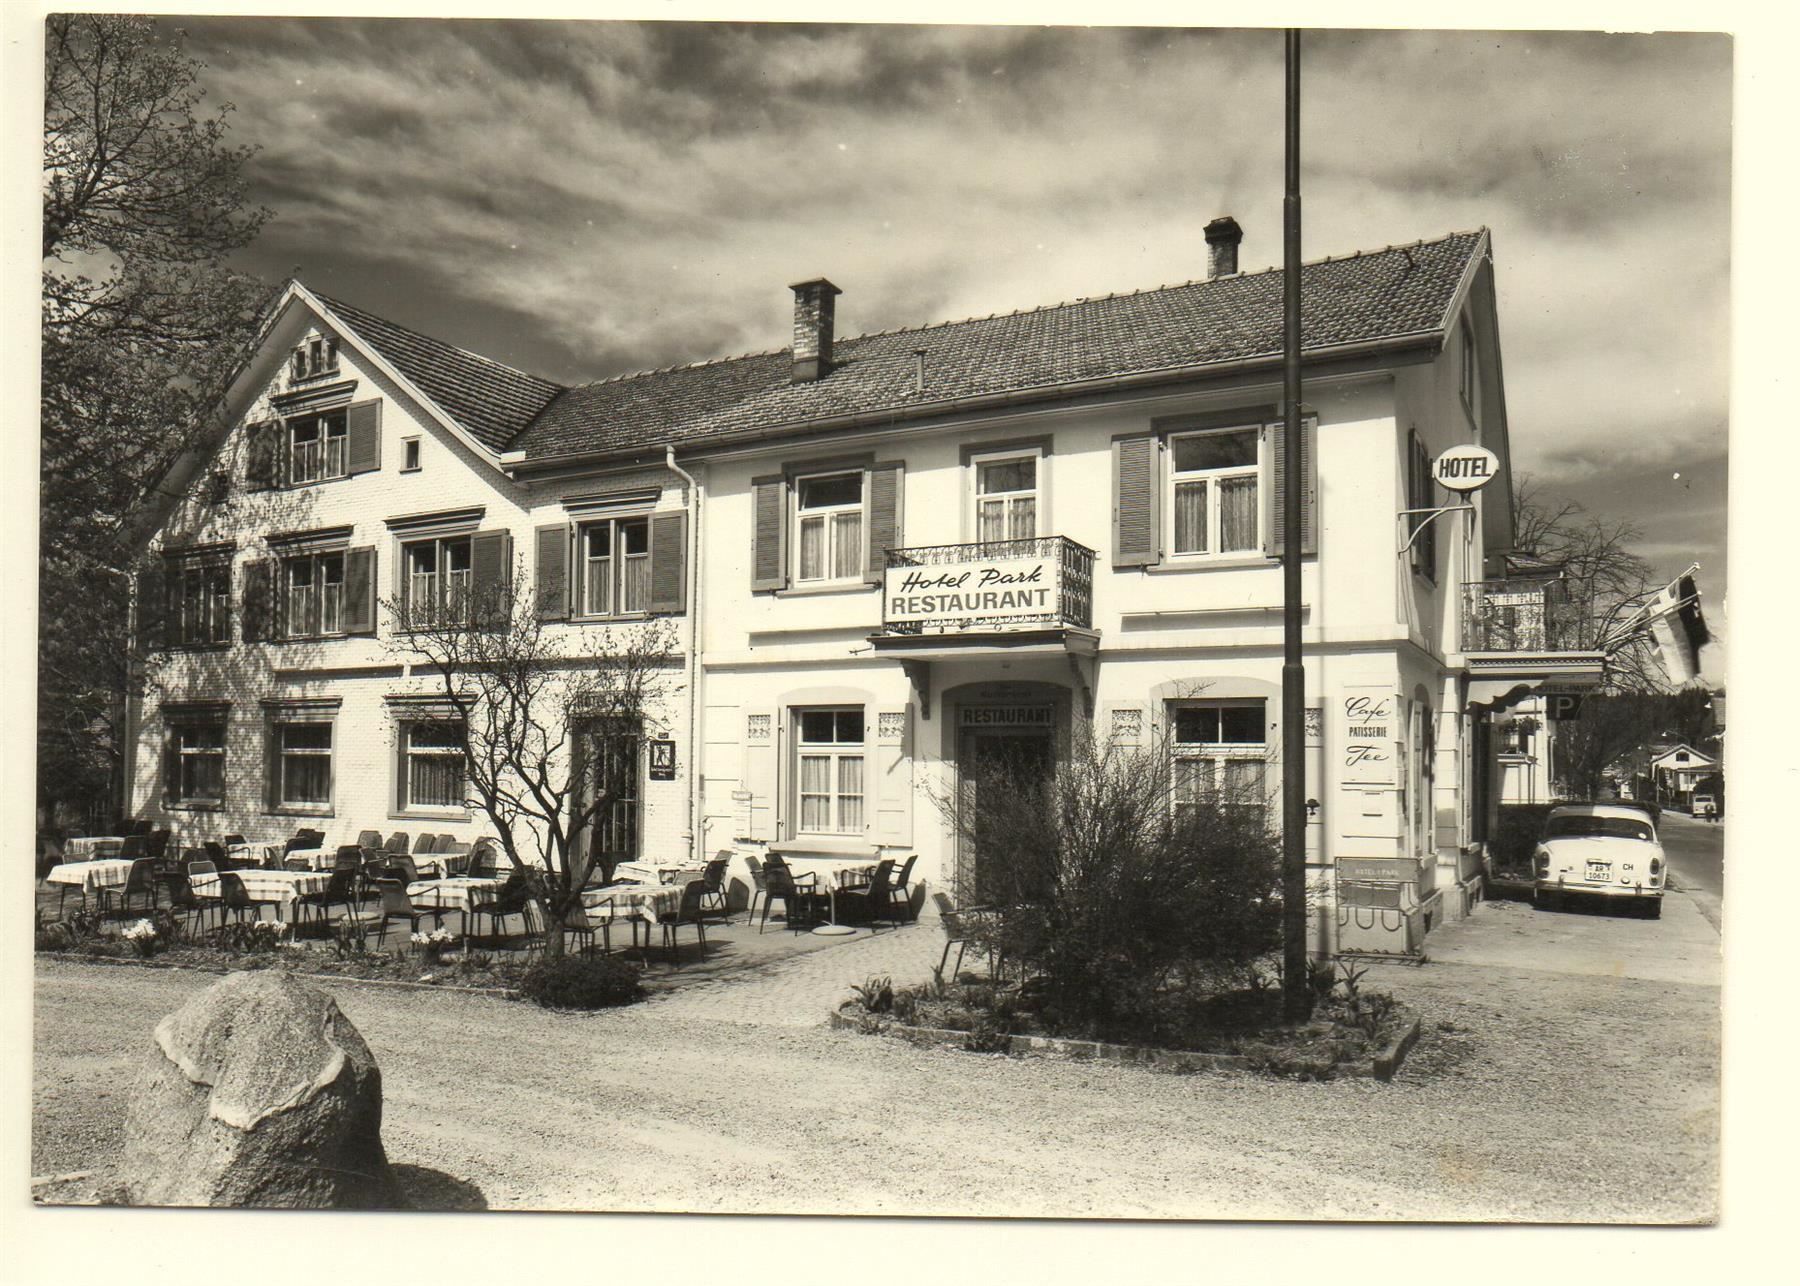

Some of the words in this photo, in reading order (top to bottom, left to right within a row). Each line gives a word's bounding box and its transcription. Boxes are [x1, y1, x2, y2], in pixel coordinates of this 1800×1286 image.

[1439, 457, 1491, 478] HOTEL
[900, 571, 971, 593] Hotel
[978, 565, 1043, 588] Park
[891, 588, 1050, 615] RESTAURANT
[963, 708, 1051, 724] RESTAURANT
[1555, 696, 1574, 719] P
[1349, 726, 1387, 737] PATISSERIE
[1345, 745, 1389, 767] Tee
[1622, 863, 1634, 871] CH
